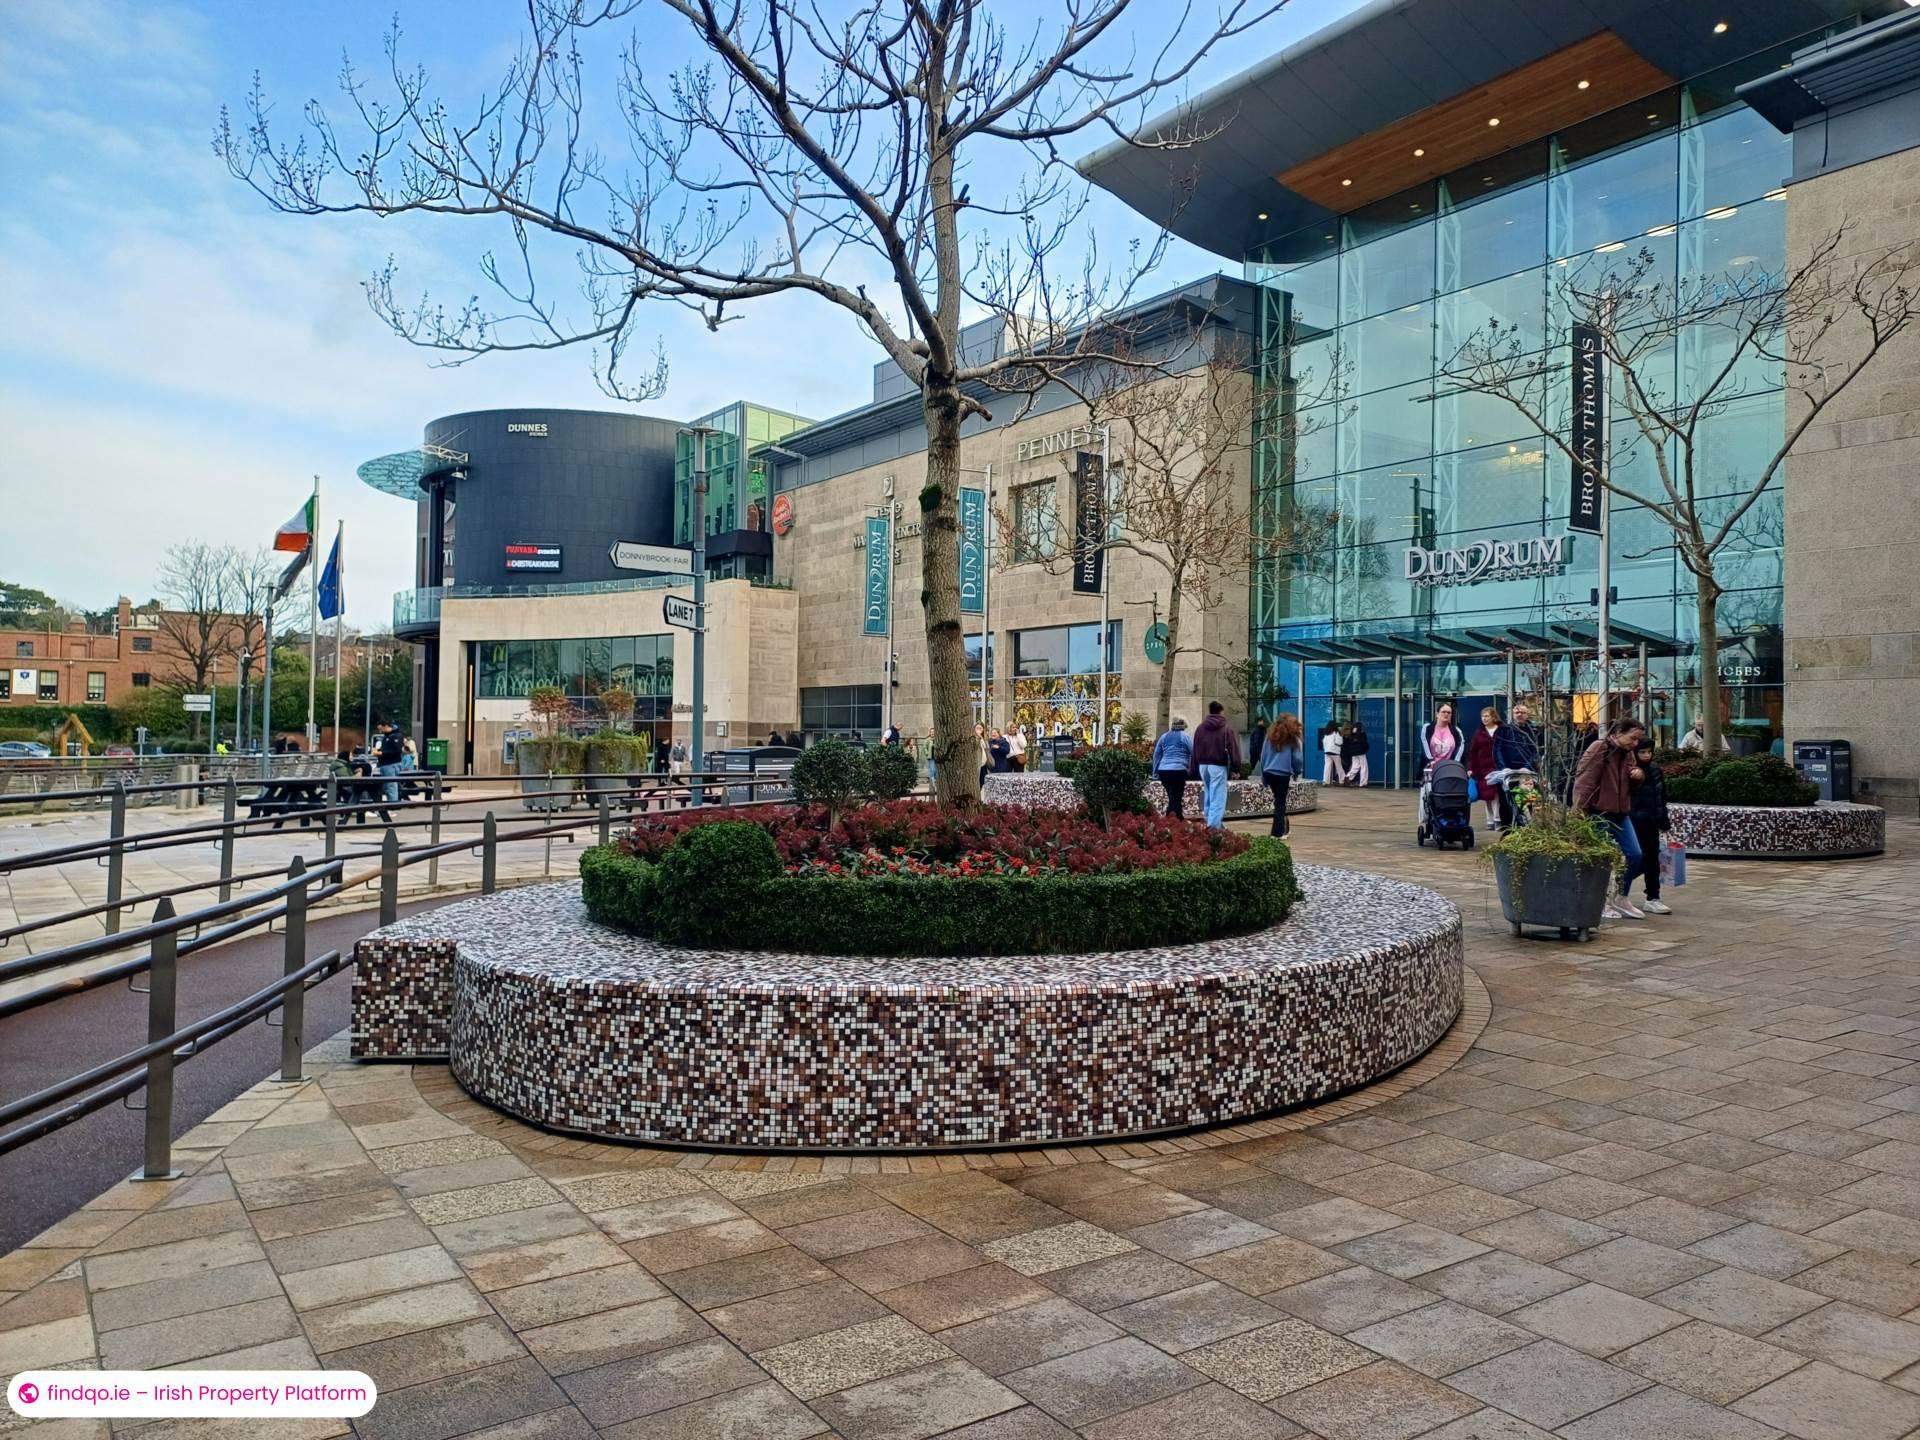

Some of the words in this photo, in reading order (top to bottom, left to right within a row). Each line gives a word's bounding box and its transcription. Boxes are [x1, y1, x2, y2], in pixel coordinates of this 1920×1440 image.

[1582, 337, 1595, 430] THOMAS
[508, 423, 548, 433] DUNNES
[1017, 424, 1106, 462] PENNEYS
[1581, 437, 1595, 516] BROWN
[620, 551, 671, 563] DONNYBROOK
[674, 557, 689, 565] FAIR
[1404, 536, 1563, 583] DUNDRUM
[668, 602, 688, 621] LANE
[688, 607, 694, 622] 7
